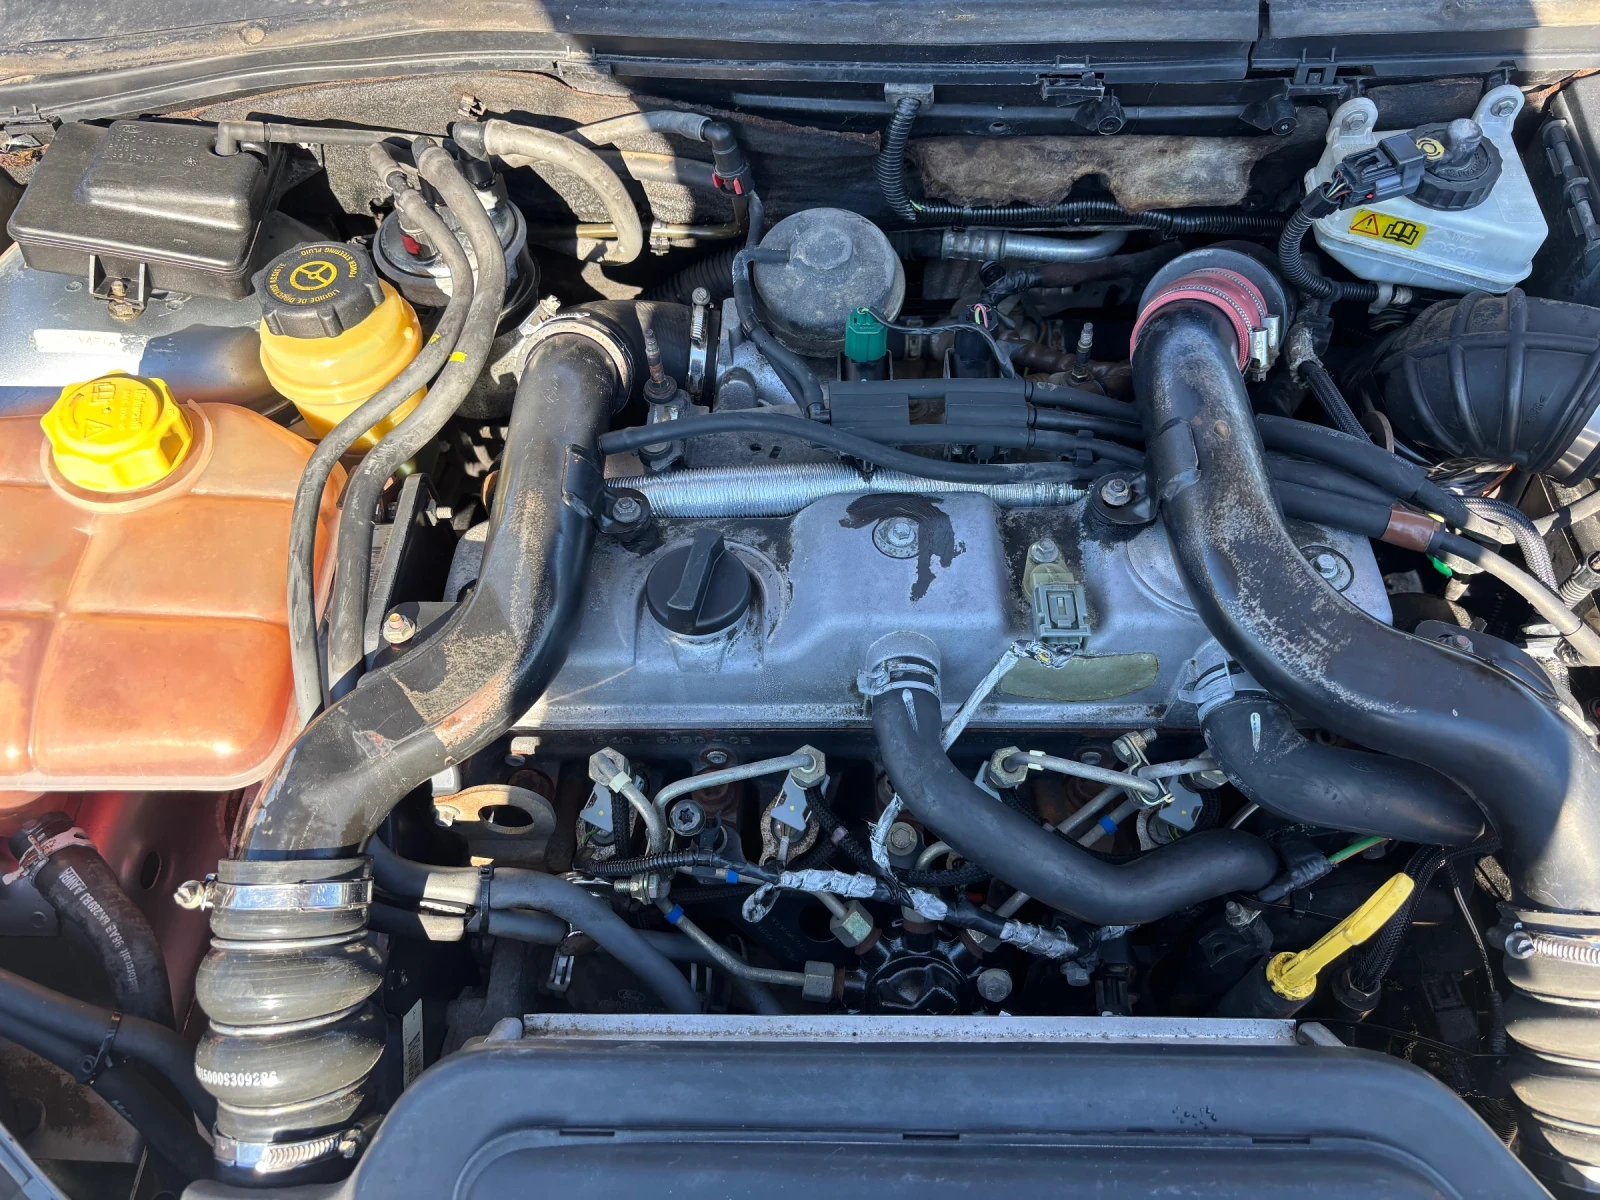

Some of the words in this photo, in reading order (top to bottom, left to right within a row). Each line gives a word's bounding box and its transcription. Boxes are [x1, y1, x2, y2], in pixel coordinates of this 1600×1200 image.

[301, 247, 322, 256] FLUID
[324, 247, 353, 261] STEERING
[1423, 239, 1478, 261] BOSCH
[348, 260, 358, 278] POWER
[310, 288, 340, 303] LIQUIDE
